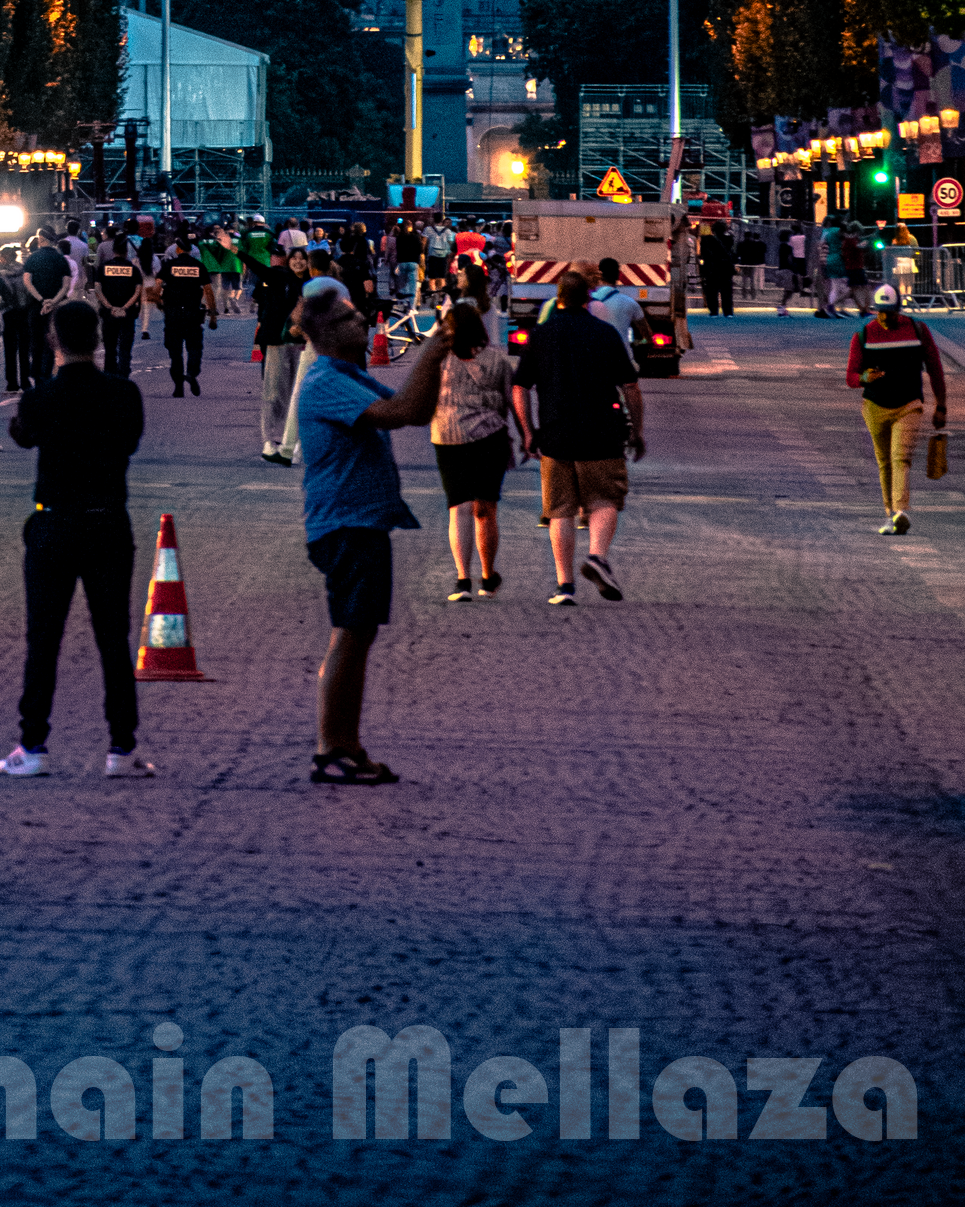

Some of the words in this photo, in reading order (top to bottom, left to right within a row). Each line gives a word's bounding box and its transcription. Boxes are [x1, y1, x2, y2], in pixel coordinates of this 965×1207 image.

[940, 188, 956, 199] 50
[106, 267, 131, 275] POLICE
[173, 268, 198, 276] POLICE
